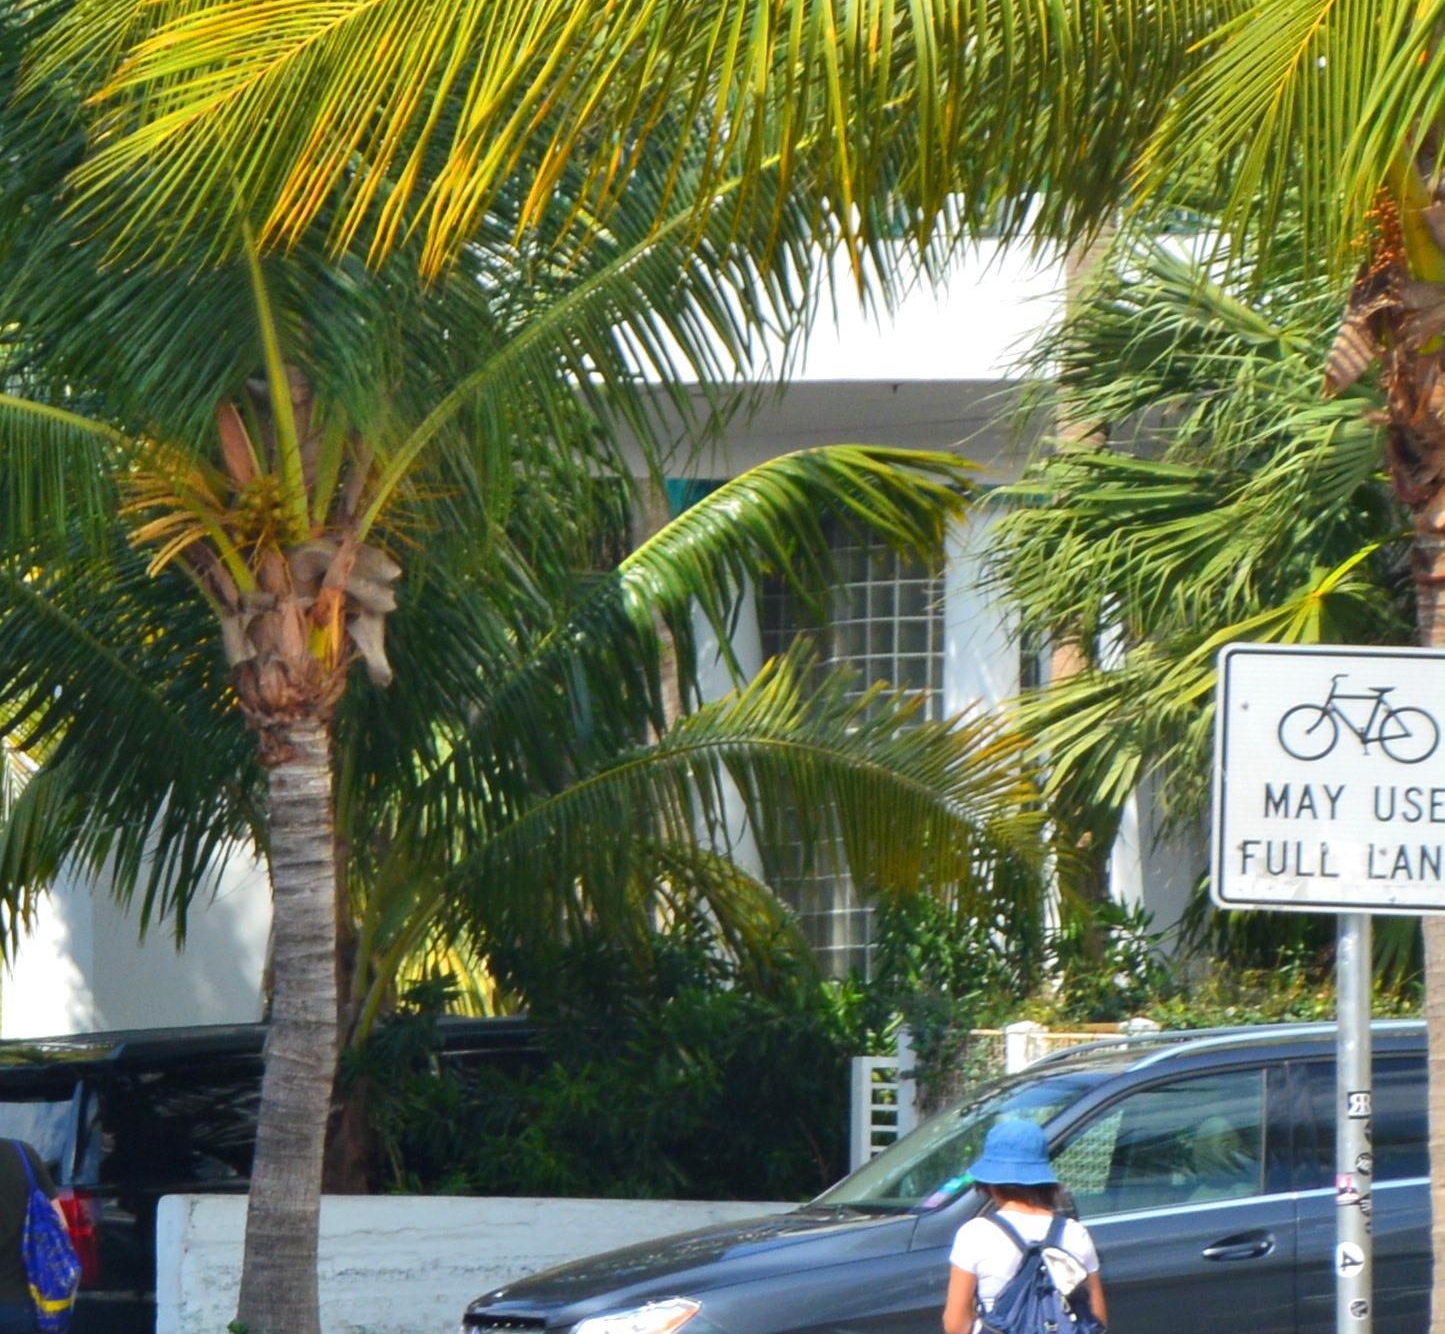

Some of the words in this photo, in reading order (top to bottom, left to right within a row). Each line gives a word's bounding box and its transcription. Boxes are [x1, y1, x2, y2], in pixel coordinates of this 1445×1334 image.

[1263, 782, 1346, 820] MAY
[1373, 785, 1445, 824] USE
[1241, 839, 1340, 878] FULL
[1367, 843, 1442, 881] LAN
